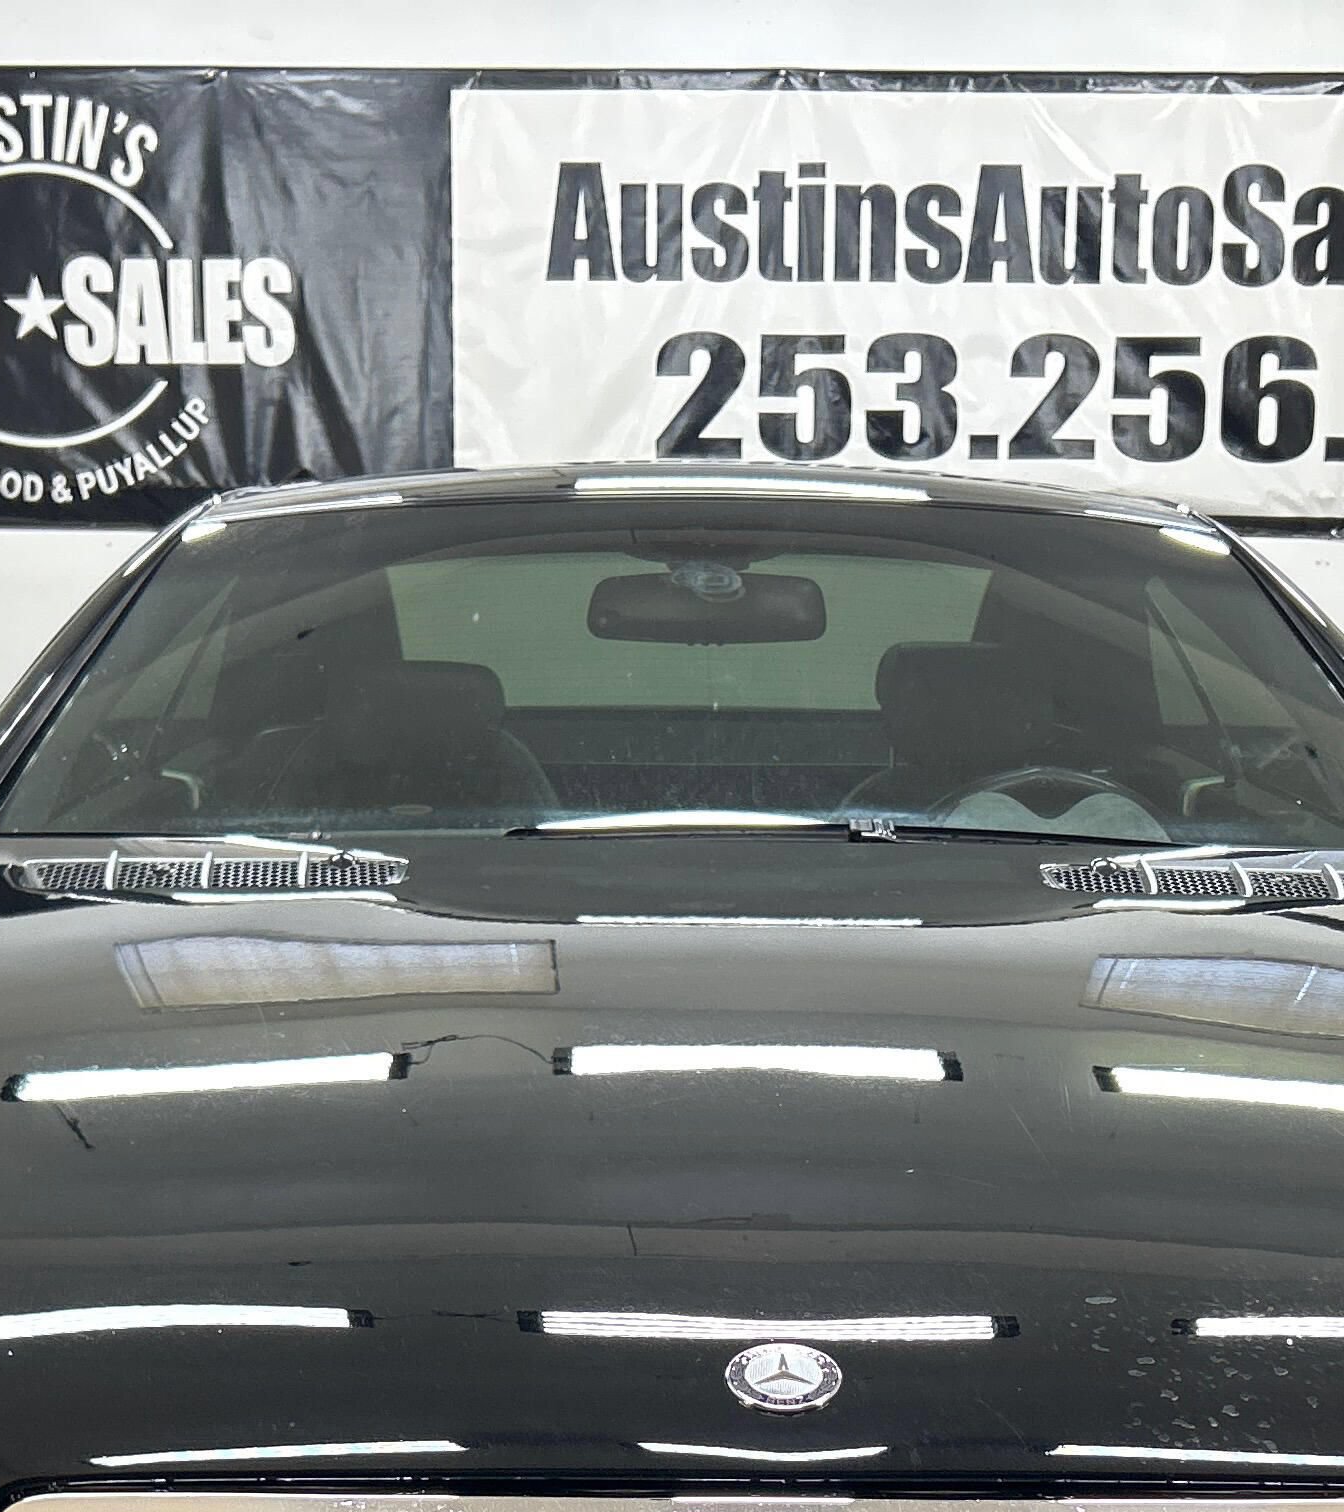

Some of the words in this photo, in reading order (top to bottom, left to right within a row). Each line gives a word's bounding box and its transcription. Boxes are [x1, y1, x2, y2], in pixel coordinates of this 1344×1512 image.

[61, 255, 295, 369] SALES
[51, 473, 74, 503] &
[77, 397, 209, 500] PUYALLUP
